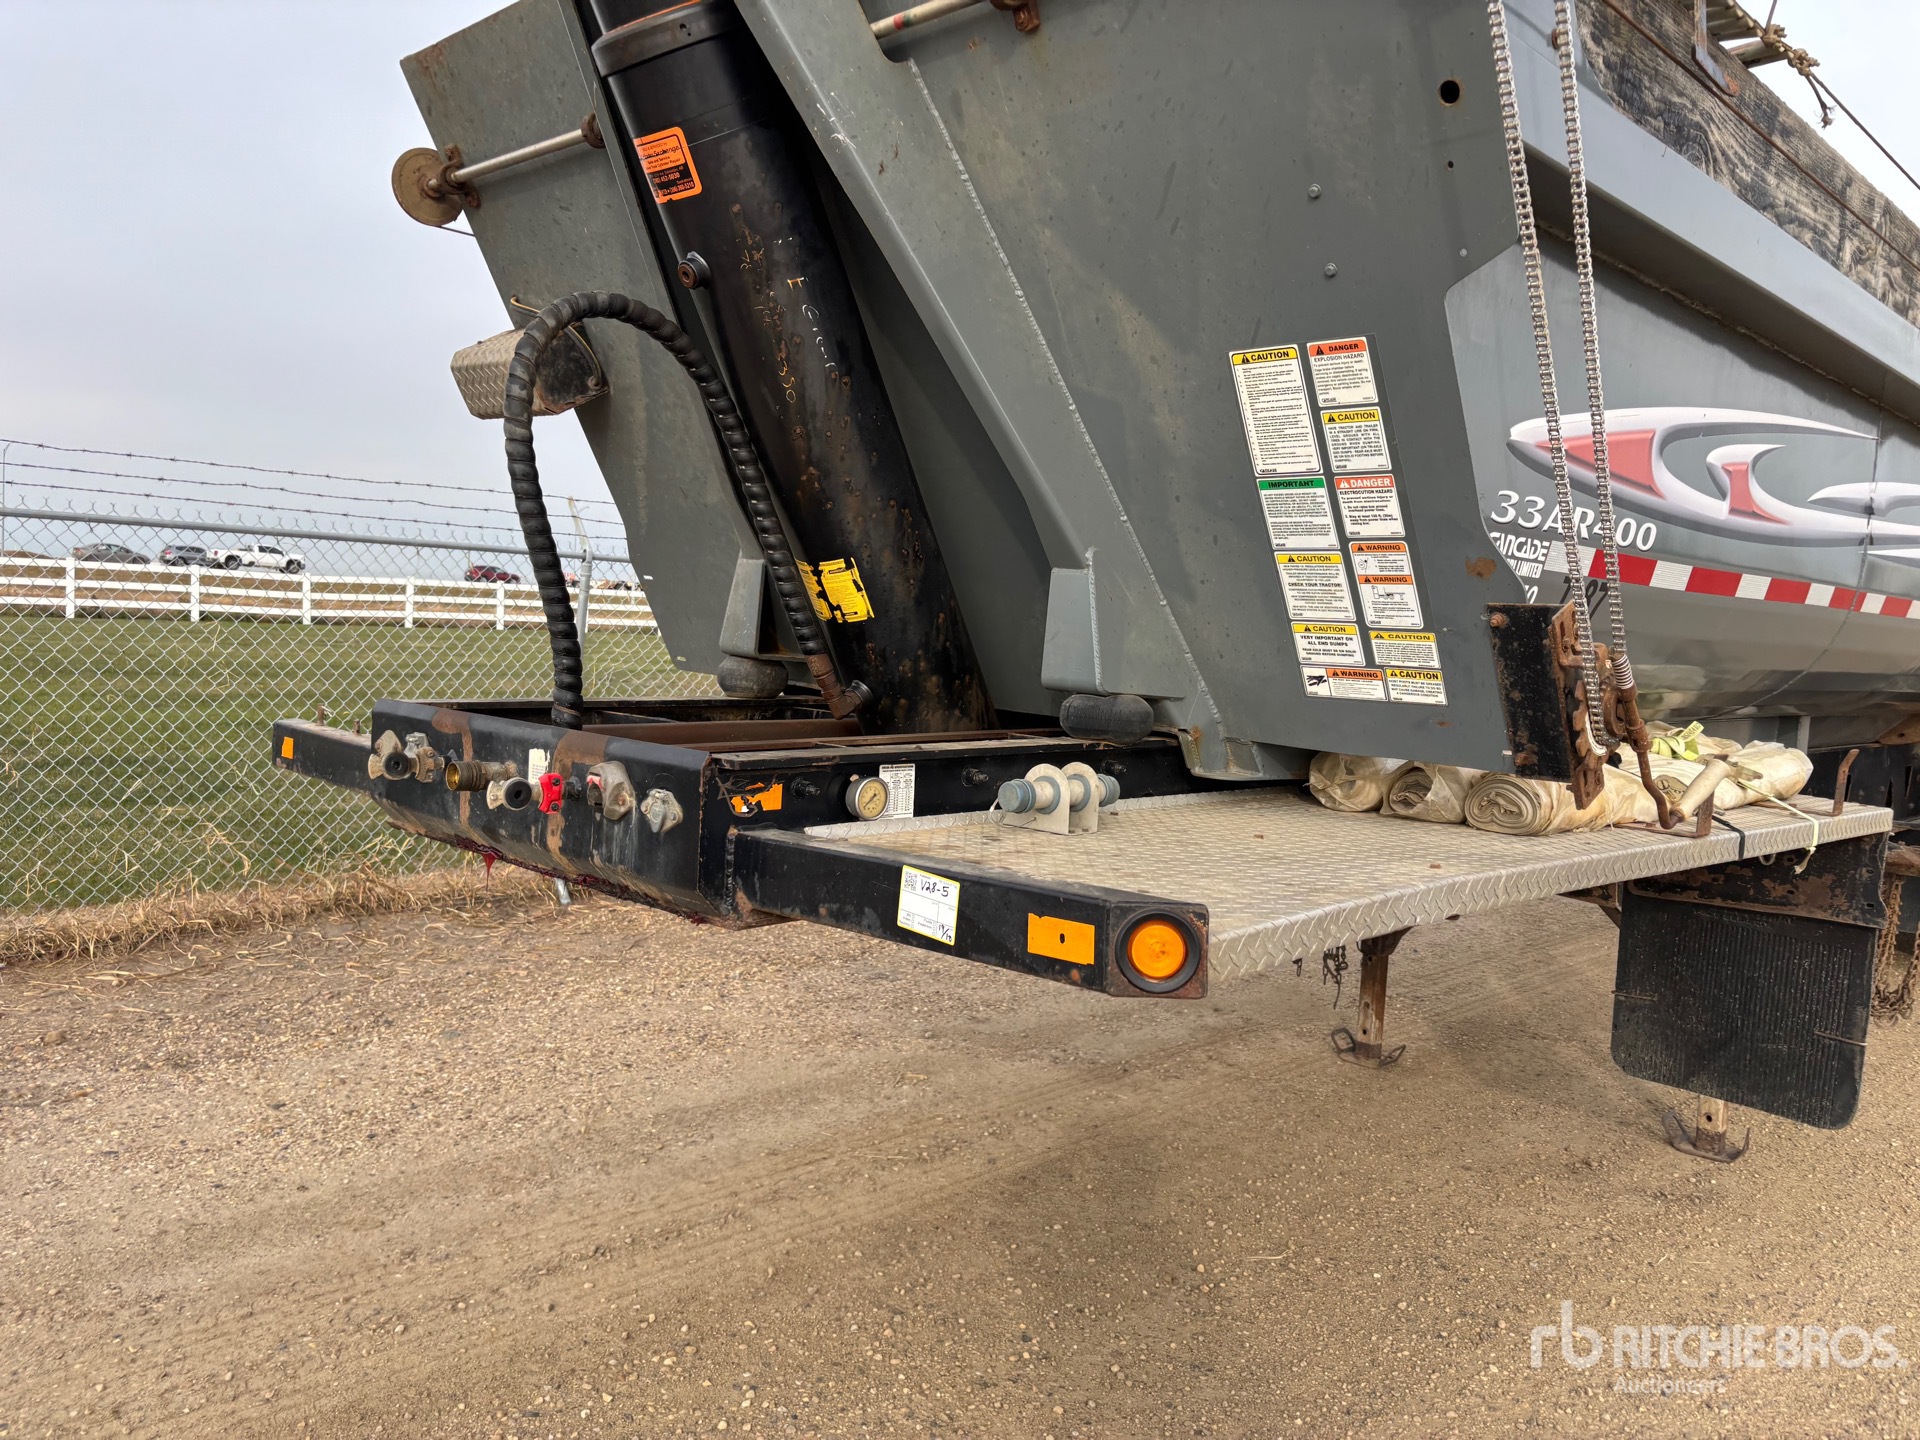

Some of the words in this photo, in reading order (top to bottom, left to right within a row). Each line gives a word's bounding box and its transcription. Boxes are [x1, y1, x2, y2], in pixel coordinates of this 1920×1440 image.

[1328, 343, 1359, 352] DANGER
[1250, 350, 1289, 361] CAUTION
[1338, 411, 1375, 421] CAUTION
[1350, 478, 1390, 487] DANGER
[1515, 559, 1543, 579] LIMITED
[1341, 670, 1378, 678] WARNING
[1399, 671, 1438, 680] CAUTION
